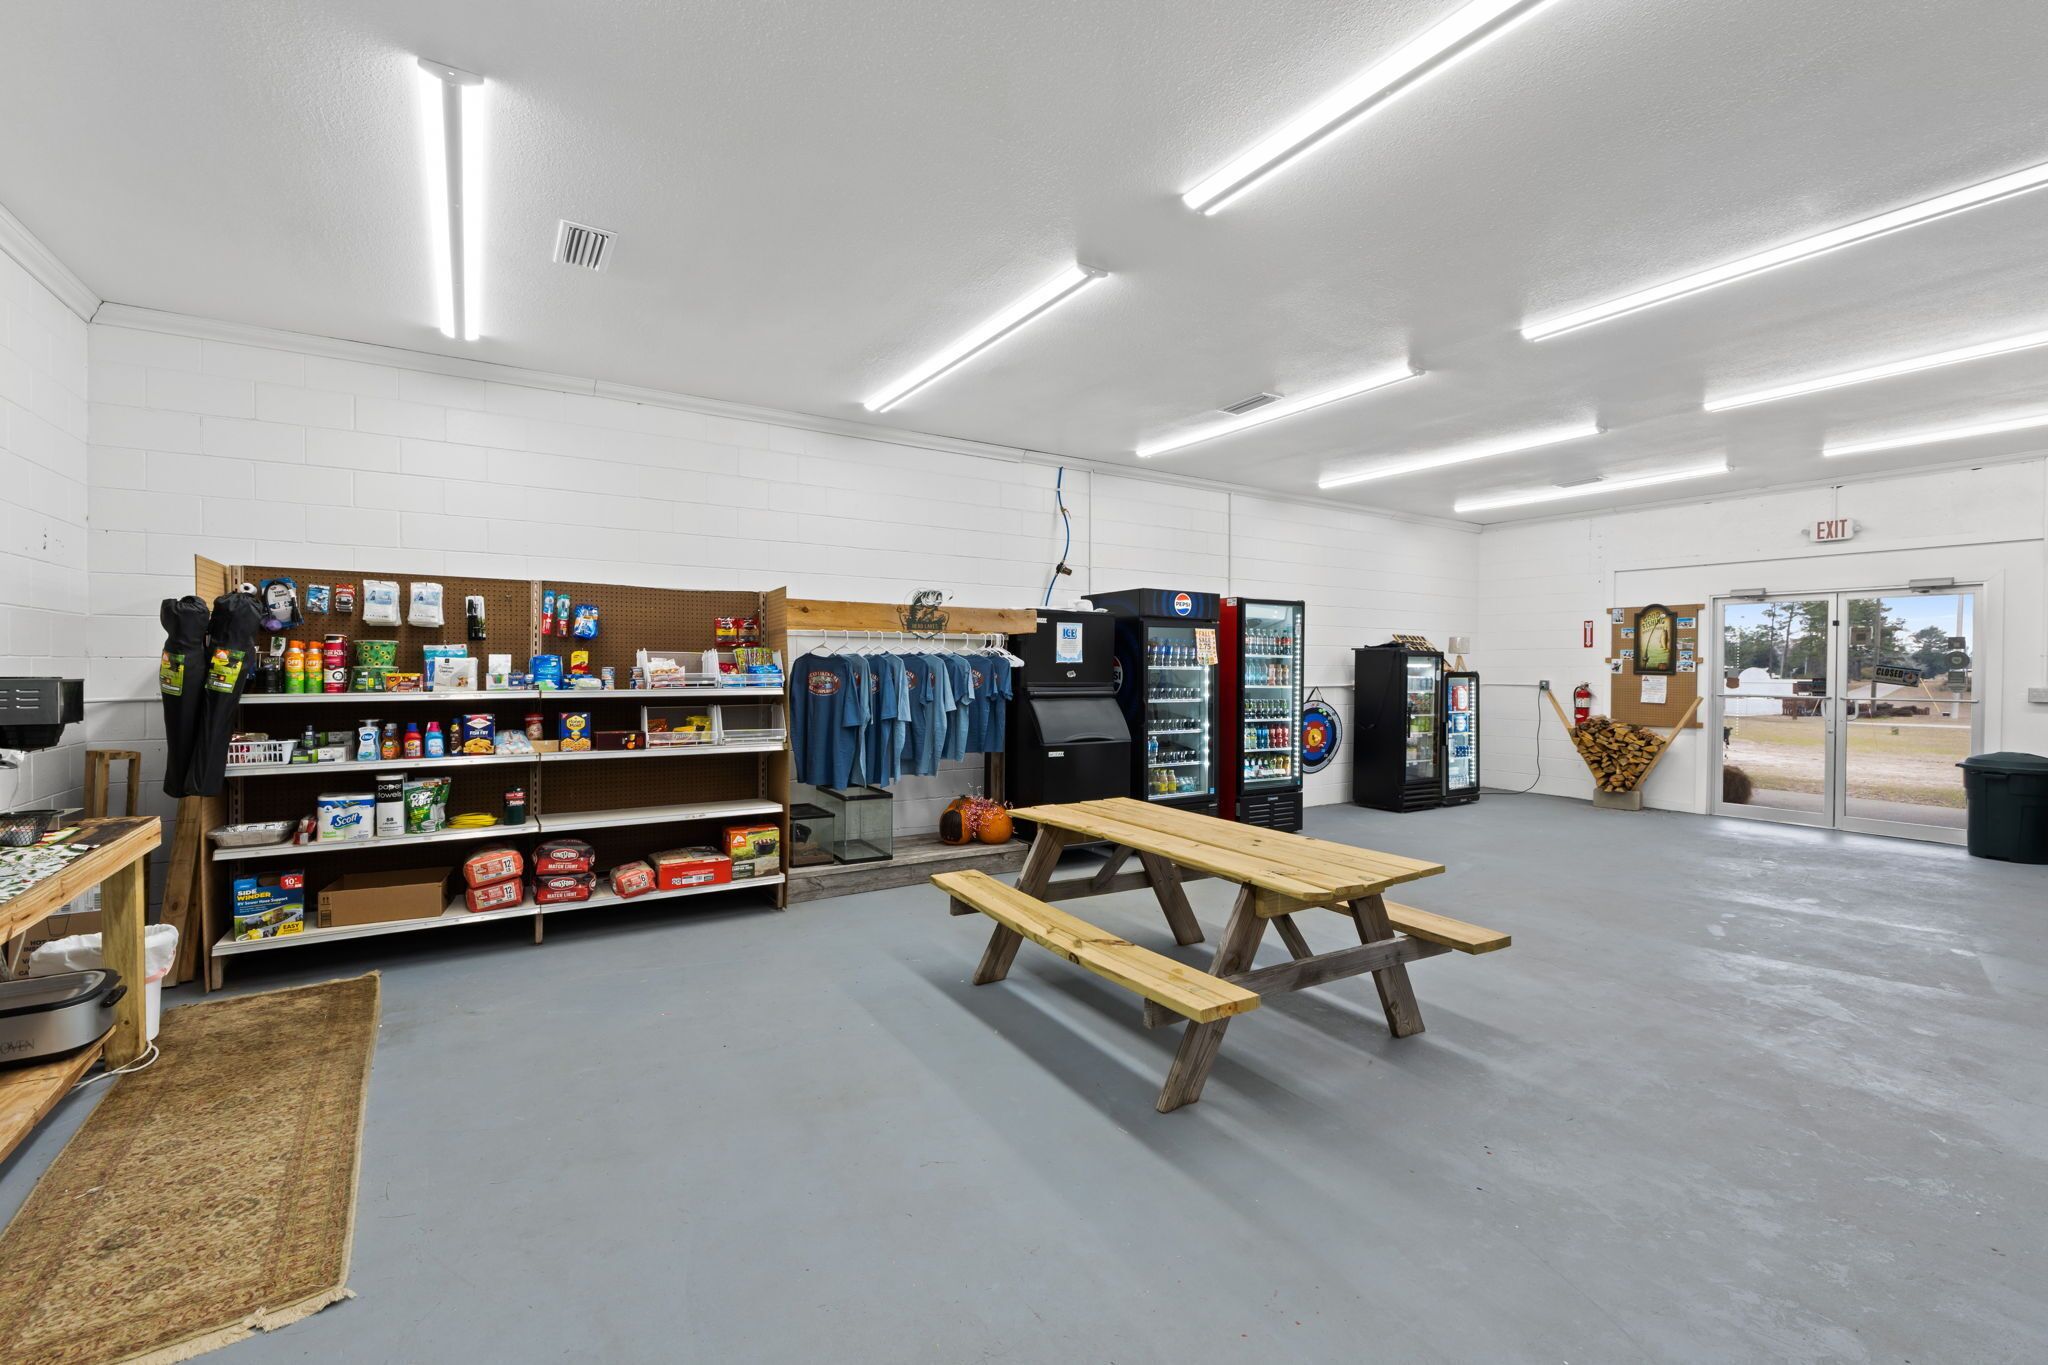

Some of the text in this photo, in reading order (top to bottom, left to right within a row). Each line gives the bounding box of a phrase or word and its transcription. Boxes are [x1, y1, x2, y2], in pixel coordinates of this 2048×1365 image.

[1816, 519, 1848, 540] EXIT
[1063, 628, 1077, 639] ICE
[1876, 667, 1904, 679] CLOSED
[378, 784, 401, 792] paper
[378, 790, 401, 798] towels
[334, 812, 360, 827] Scott
[552, 851, 577, 859] KINGSFORD
[503, 860, 512, 868] 12
[550, 880, 575, 888] KINGSFORD
[505, 886, 512, 894] 12
[237, 892, 271, 902] WINDER
